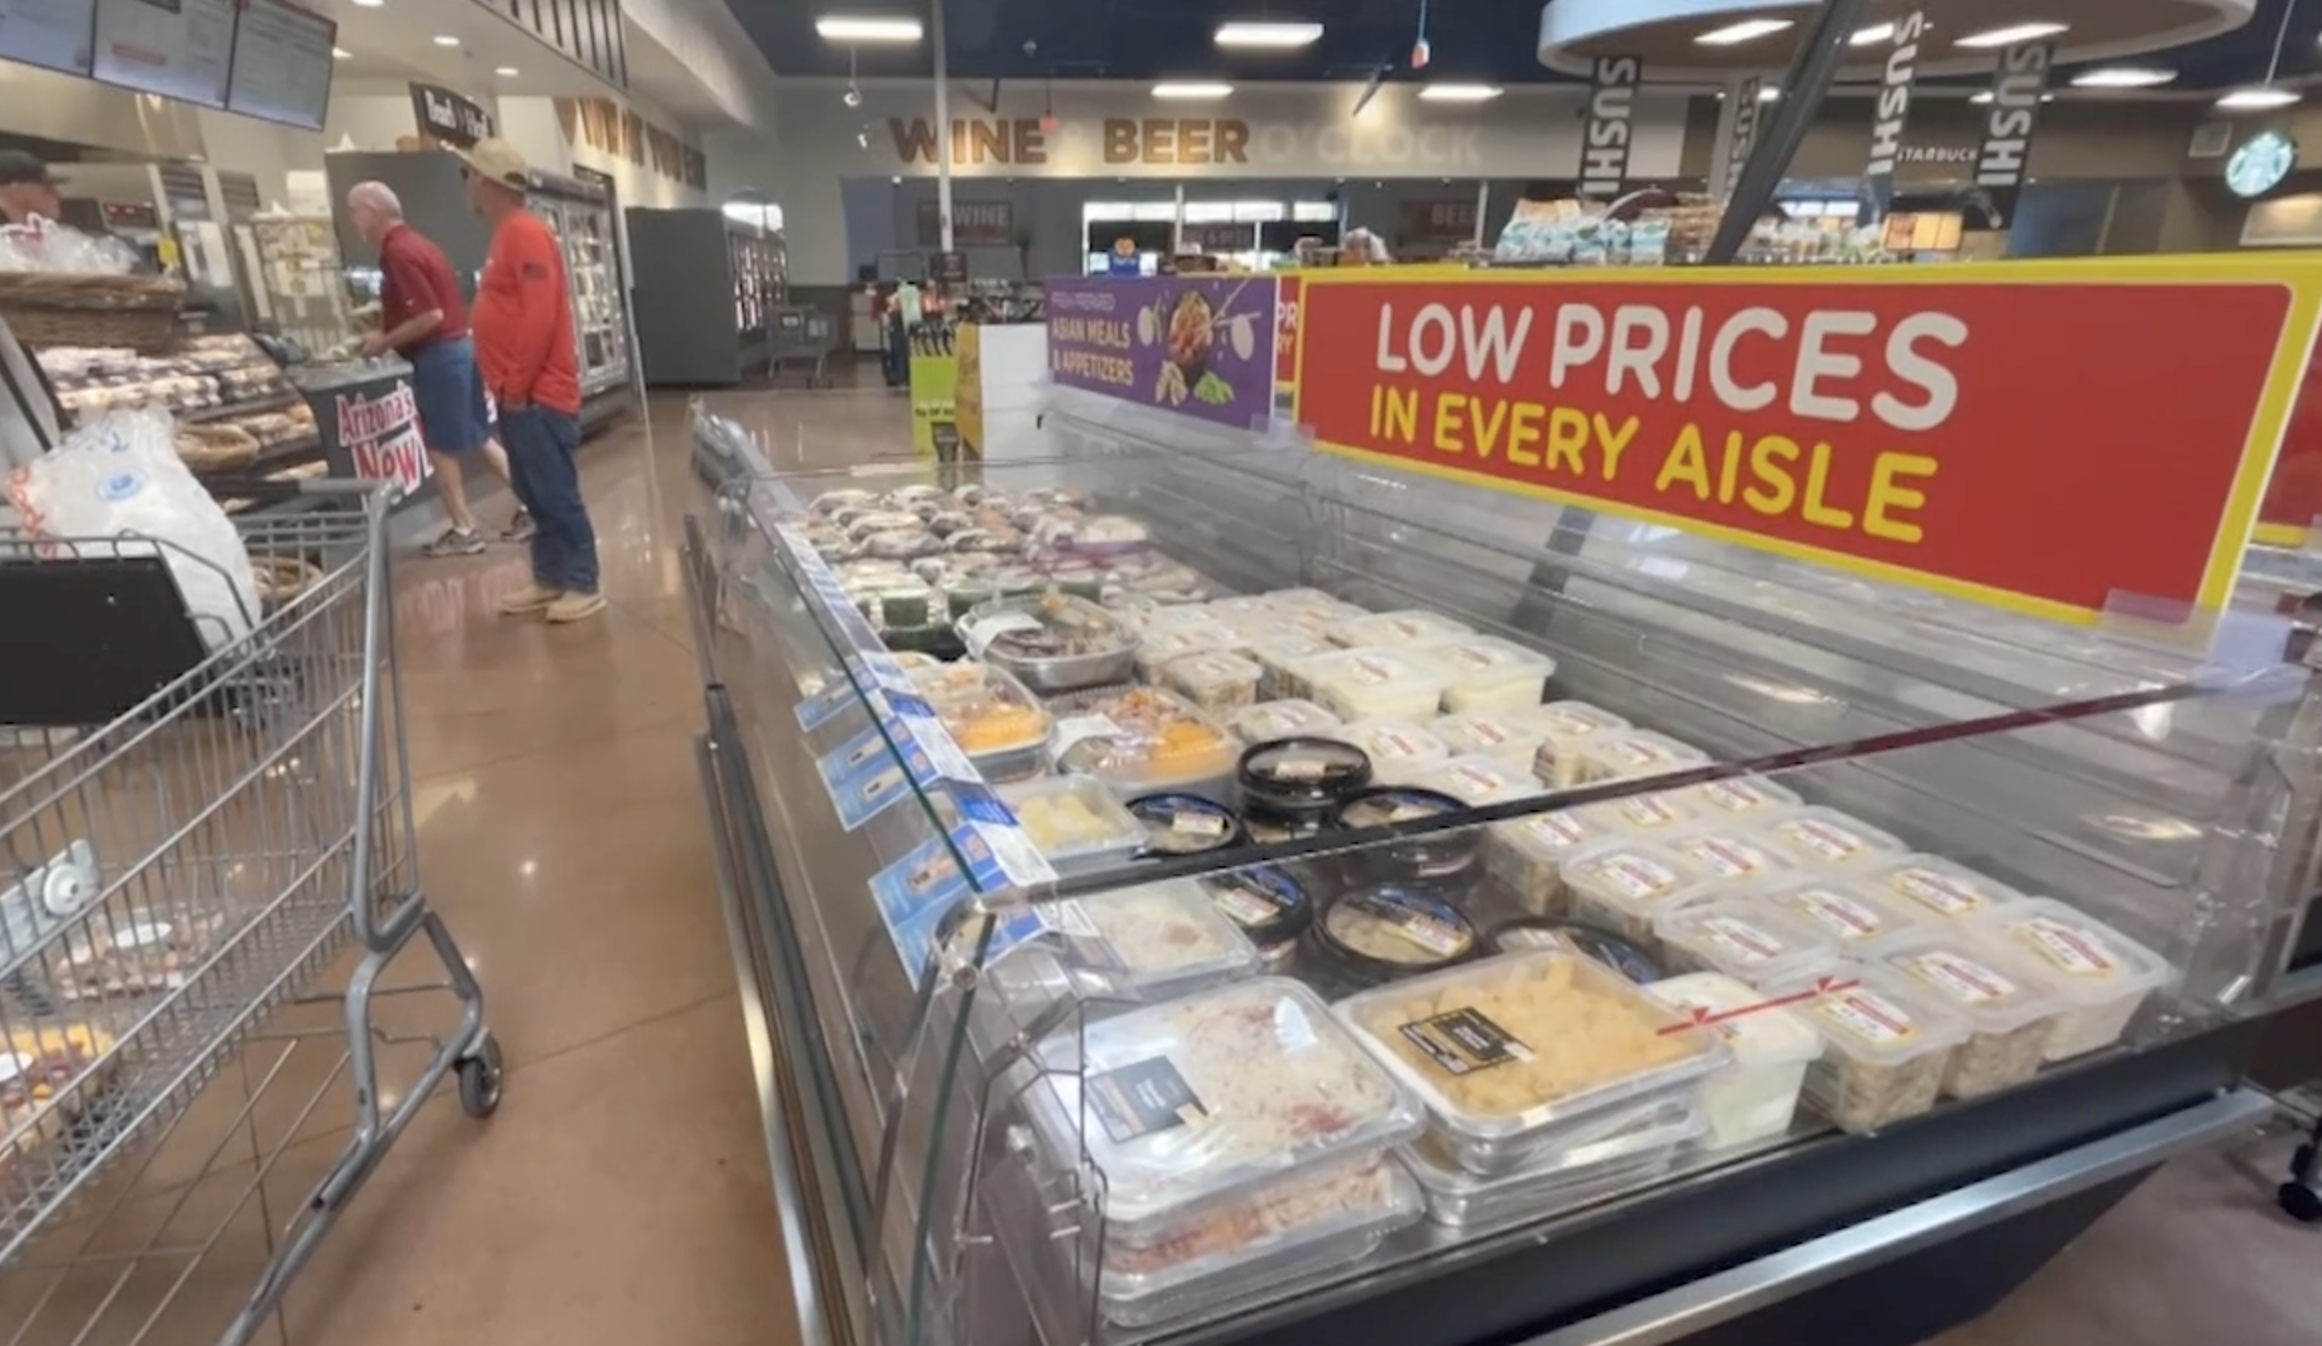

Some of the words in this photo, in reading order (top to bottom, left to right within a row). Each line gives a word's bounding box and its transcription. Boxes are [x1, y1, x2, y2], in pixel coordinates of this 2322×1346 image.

[1582, 57, 1636, 193] SUSHI
[1867, 11, 1923, 175] SUSHI
[1977, 45, 2047, 186] SUSHI
[889, 118, 1046, 164] WINE
[1103, 119, 1249, 164] BEER
[1261, 122, 1483, 166] O'CLOCK
[953, 204, 1008, 226] WINE
[1053, 317, 1086, 342] ASIAN
[1087, 319, 1131, 349] MEALS
[1063, 350, 1134, 387] APPETIZERS
[1377, 302, 1533, 384] LOW
[1550, 303, 1968, 430] PRICES
[336, 381, 416, 446] Arizona's
[1370, 384, 1418, 443] IN
[1434, 392, 1640, 481] EVERY
[1655, 422, 1938, 543] AISLE
